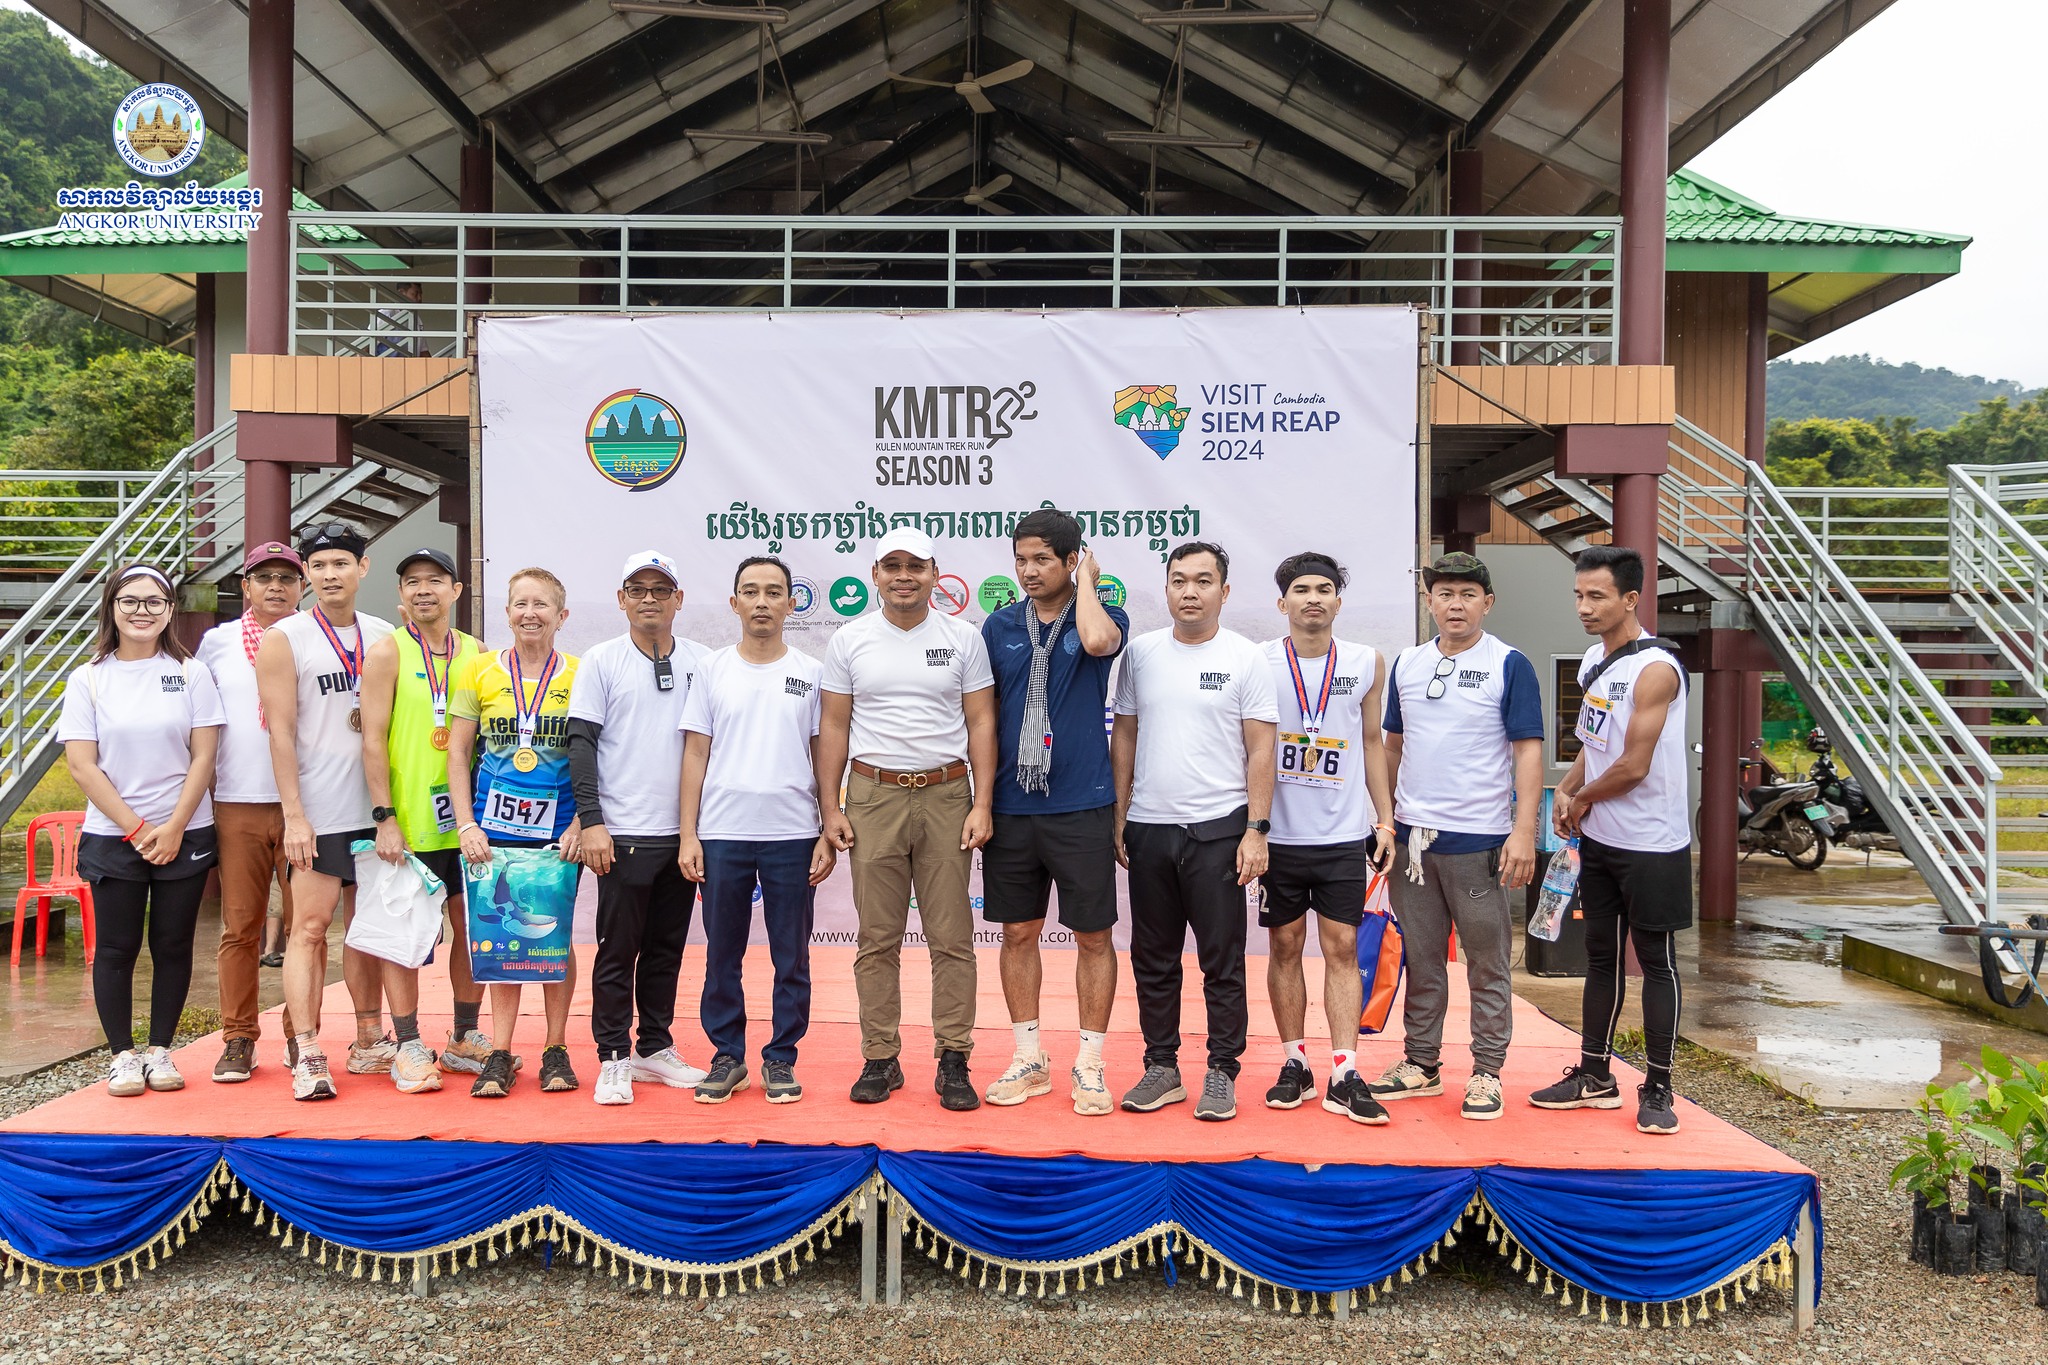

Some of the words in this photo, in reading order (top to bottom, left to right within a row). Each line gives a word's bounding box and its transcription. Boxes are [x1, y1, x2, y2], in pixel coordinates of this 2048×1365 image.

[1200, 383, 1267, 405] VISIT
[1273, 392, 1326, 405] Cambodia
[874, 385, 992, 439] KMTR
[1201, 411, 1264, 434] SIEM
[1272, 410, 1341, 432] REAP
[875, 442, 902, 451] KULEN
[903, 441, 944, 451] MOUNTAIN
[945, 441, 967, 451] TREK
[967, 441, 985, 450] RUN
[1201, 439, 1265, 461] 2024
[875, 455, 971, 486] SEASON
[978, 454, 993, 486] 3
[161, 675, 183, 685] KMTR
[1200, 672, 1222, 682] KMTR
[1459, 669, 1482, 681] KMTR
[785, 676, 806, 690] KMTR
[785, 687, 801, 697] SEASON
[492, 735, 545, 747] TRIATON
[493, 793, 550, 825] 1547
